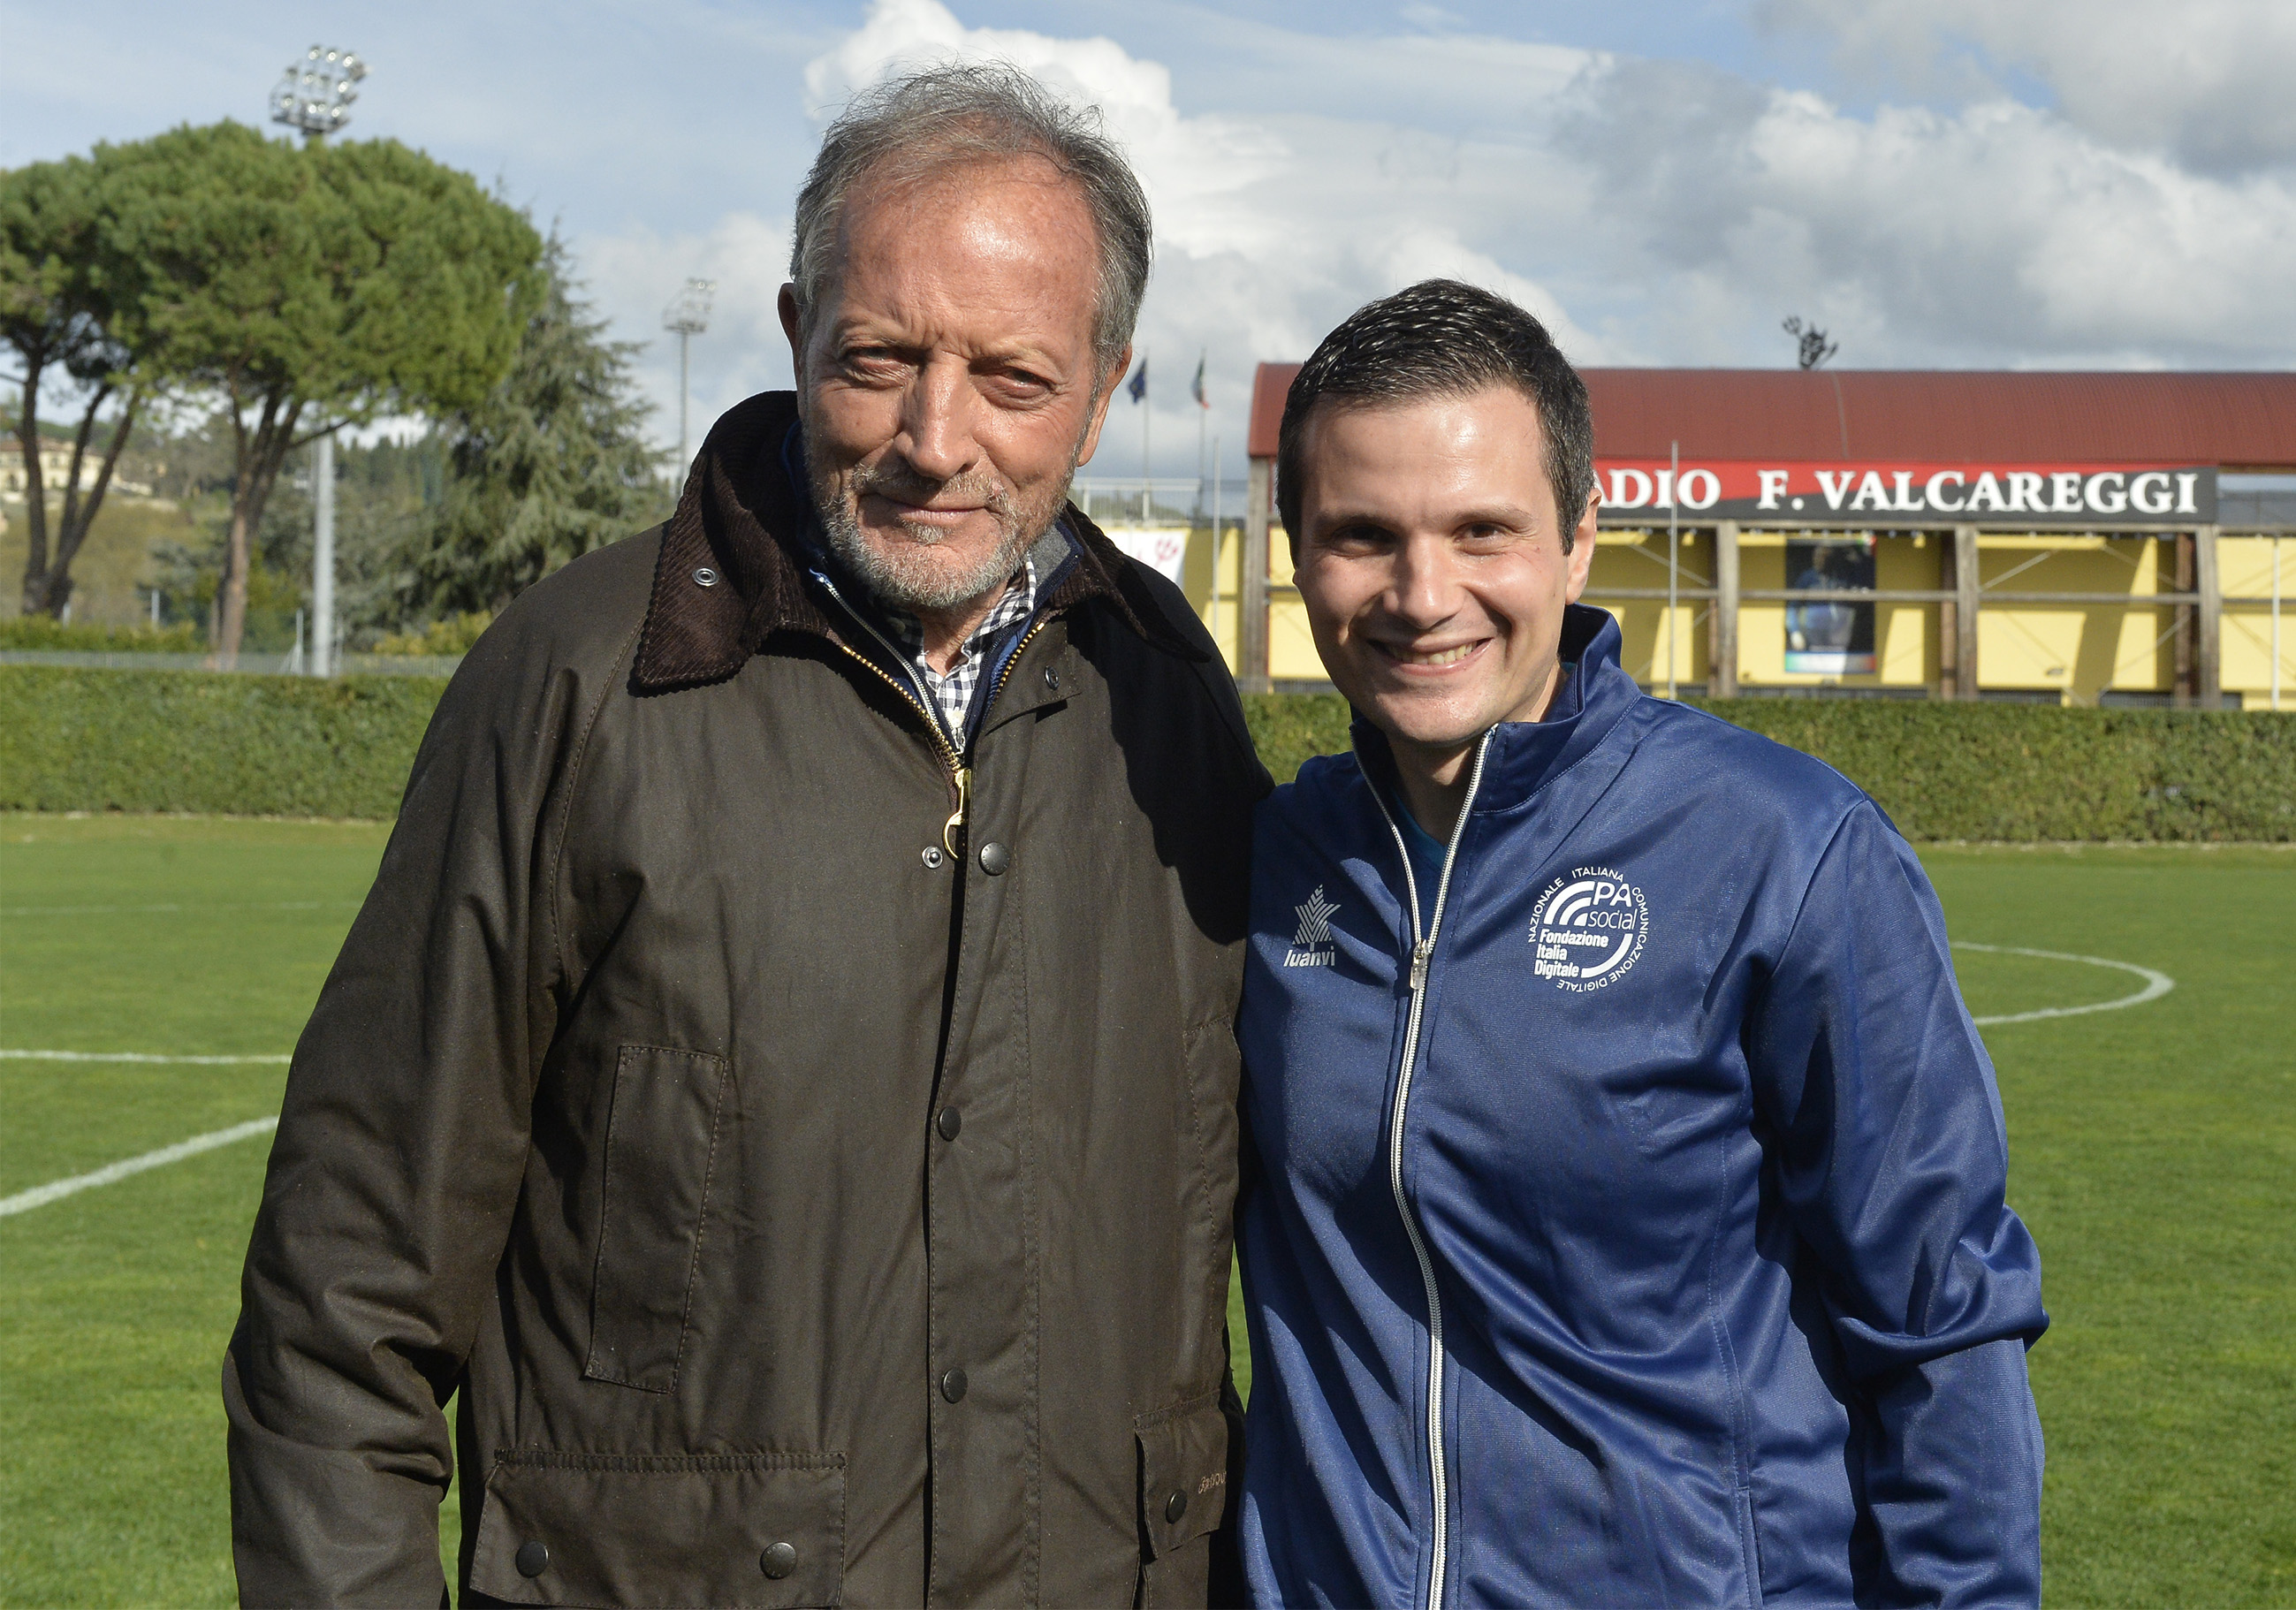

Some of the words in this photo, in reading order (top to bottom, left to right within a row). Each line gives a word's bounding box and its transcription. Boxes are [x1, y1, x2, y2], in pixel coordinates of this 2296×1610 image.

[1756, 469, 1805, 510] F.
[1814, 470, 2199, 513] VALCAREGGI
[1571, 866, 1623, 883] ITALIANA
[1593, 881, 1632, 908] PA
[1528, 877, 1564, 943] NAZIONALE
[1588, 908, 1638, 930] social
[1540, 929, 1609, 947] Fondazione
[1608, 887, 1649, 983] COMUNICAZIONE
[1283, 945, 1335, 967] luanvi
[1536, 943, 1568, 961] Italia
[1534, 959, 1580, 980] Digitale
[1556, 977, 1608, 992] DIGITALE
